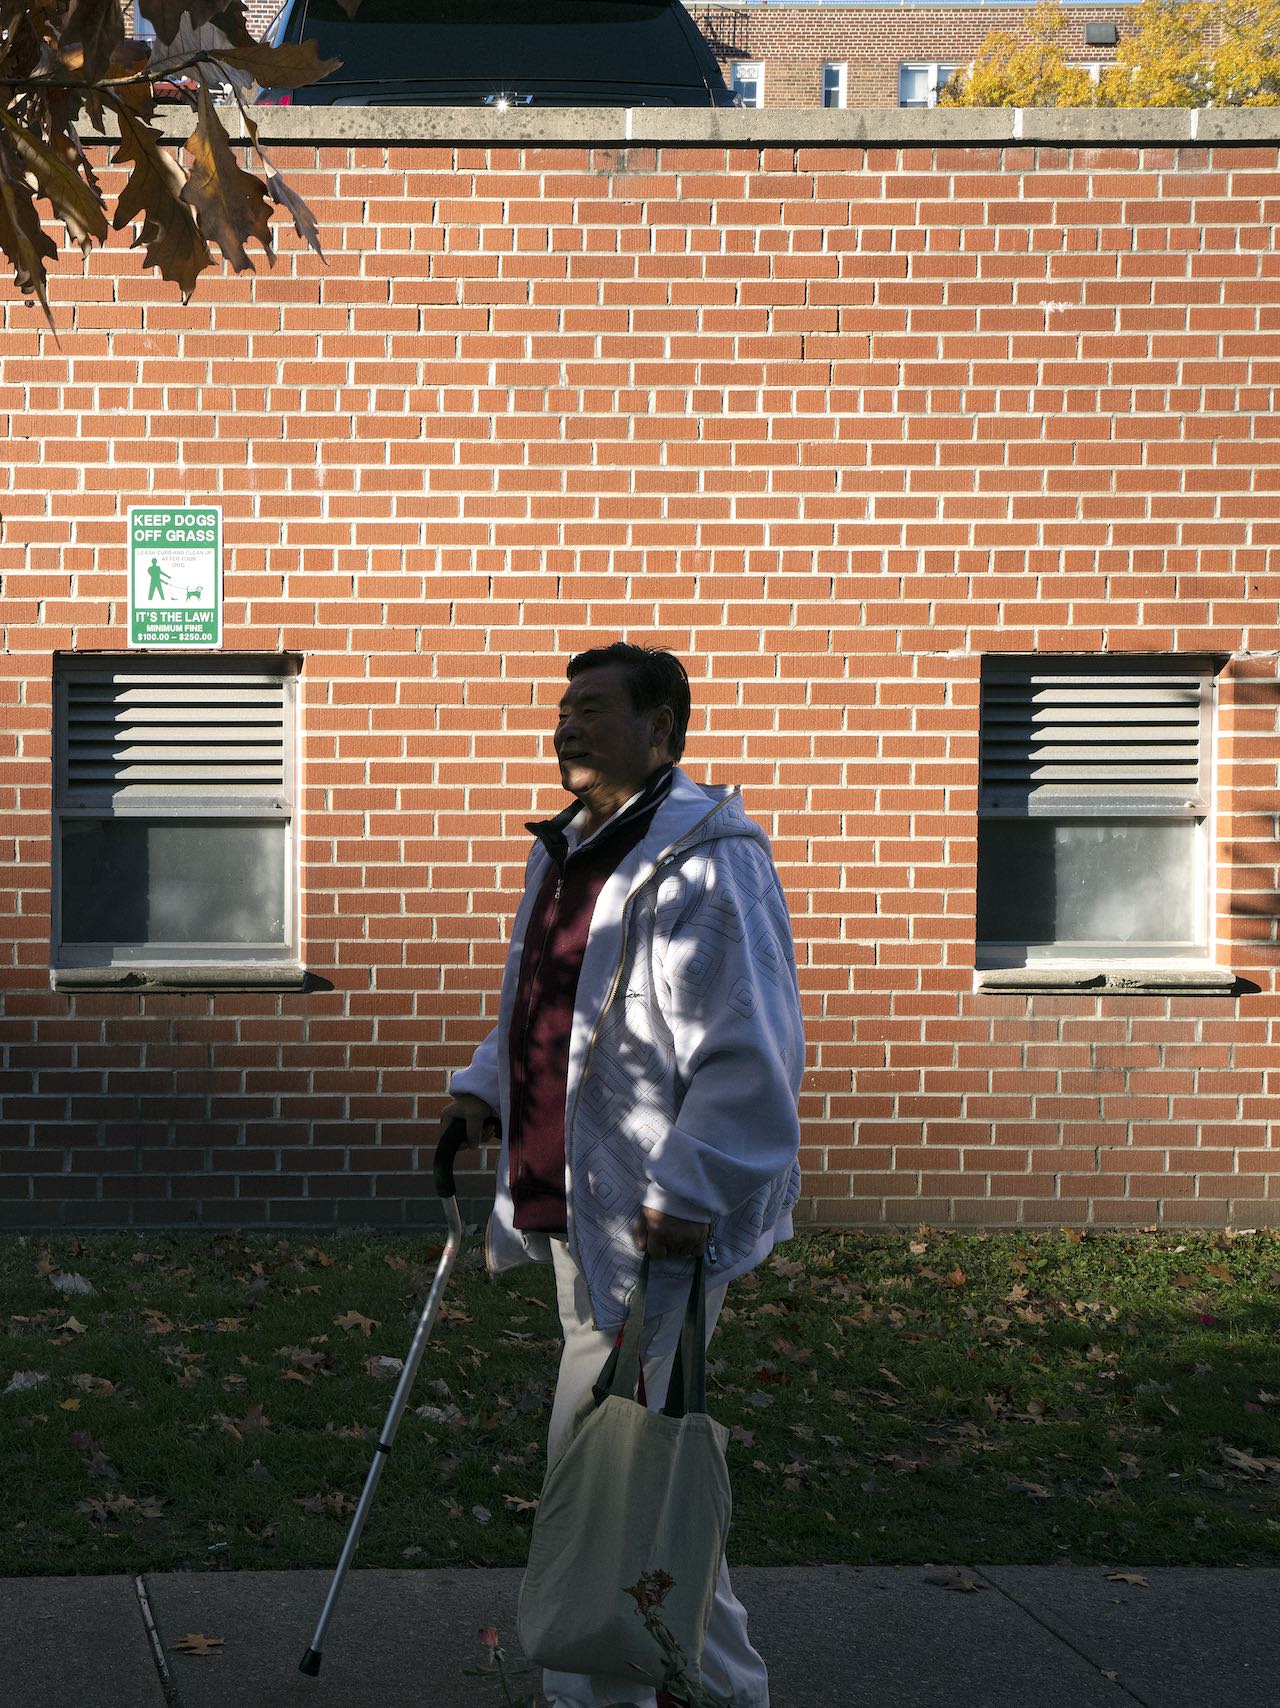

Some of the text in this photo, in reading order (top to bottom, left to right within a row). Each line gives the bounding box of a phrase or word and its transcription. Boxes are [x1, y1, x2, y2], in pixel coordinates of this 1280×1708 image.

[134, 514, 216, 526] KEEP DOGS
[134, 530, 215, 542] OFF GRASS
[136, 611, 214, 622] IT'S THE LAW!
[146, 624, 203, 632] MINIMUM FINE
[137, 633, 170, 641] $100.00
[179, 633, 212, 641] $250.00
